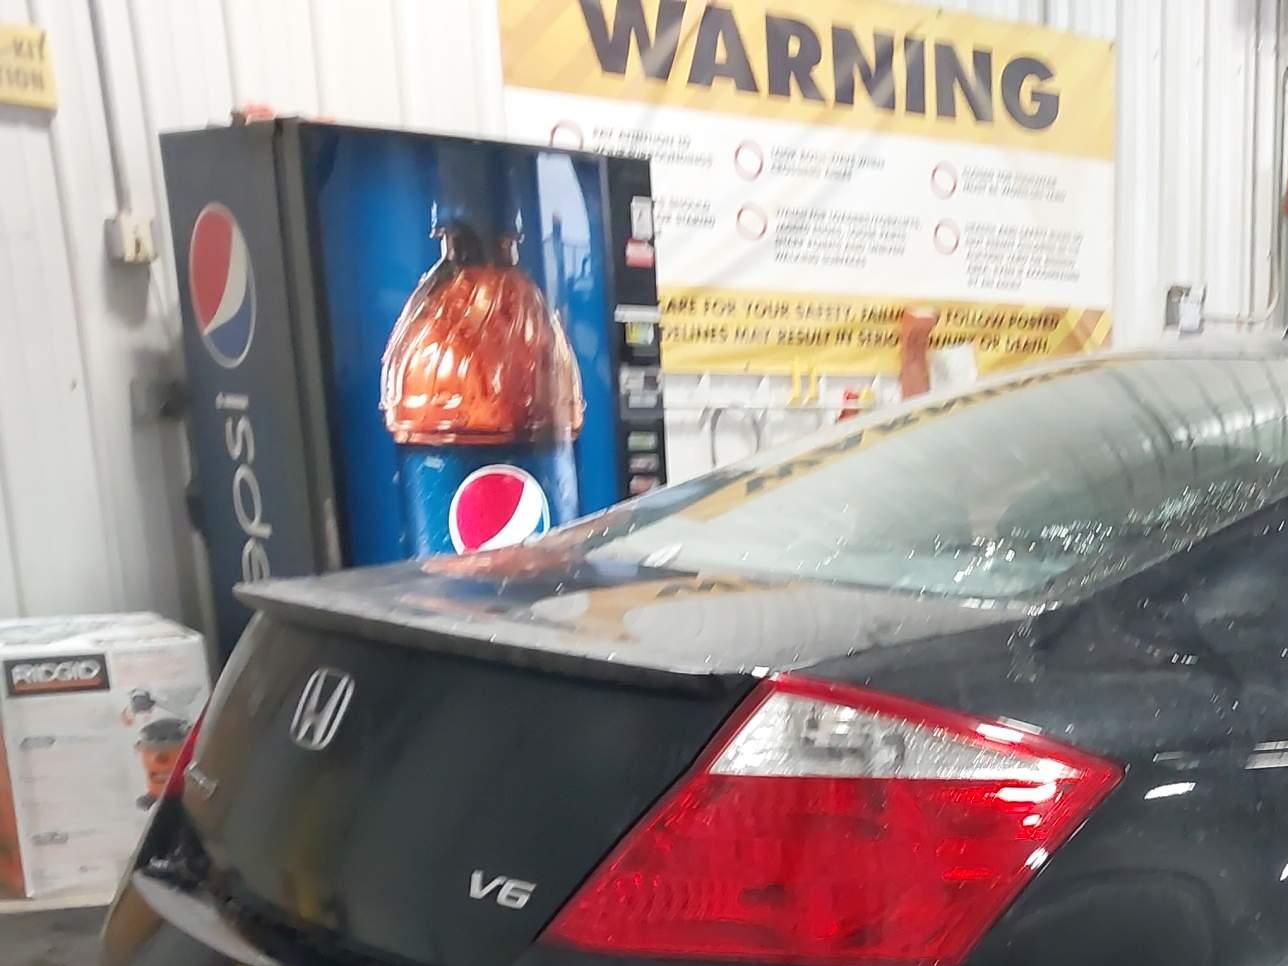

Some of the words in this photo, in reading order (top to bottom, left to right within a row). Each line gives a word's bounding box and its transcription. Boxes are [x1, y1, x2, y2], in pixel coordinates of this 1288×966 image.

[577, 0, 1061, 131] WARNING
[747, 302, 789, 319] YOUR
[662, 325, 728, 344] DELINES
[776, 328, 831, 346] RESULT
[856, 330, 900, 348] SERIO
[216, 392, 272, 582] epsi
[11, 660, 101, 686] RIDGID
[469, 868, 537, 910] V6
